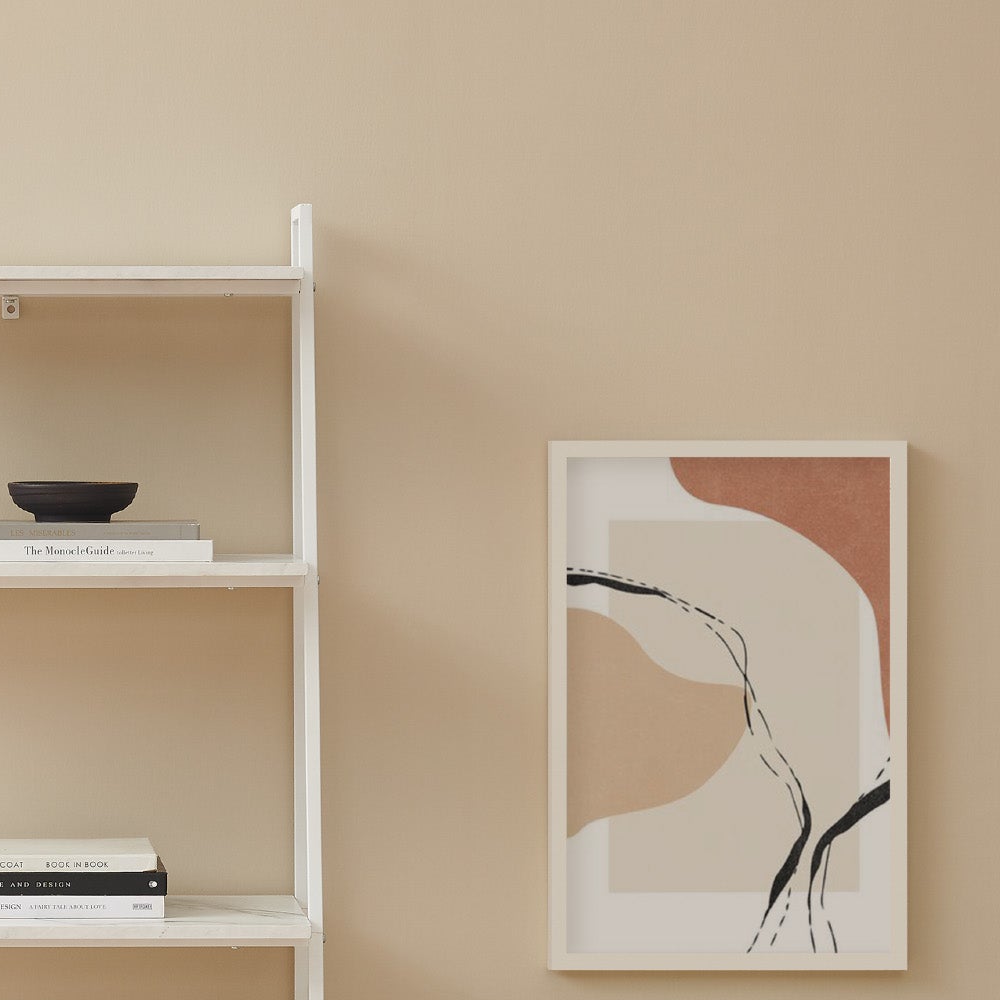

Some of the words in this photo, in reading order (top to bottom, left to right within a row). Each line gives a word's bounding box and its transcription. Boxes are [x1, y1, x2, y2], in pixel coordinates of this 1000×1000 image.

[24, 545, 42, 555] The
[45, 545, 114, 555] MonocleGuide
[0, 861, 23, 869] COAT
[45, 861, 70, 869] BOOK
[73, 861, 82, 869] IN
[84, 861, 109, 869] BOOK
